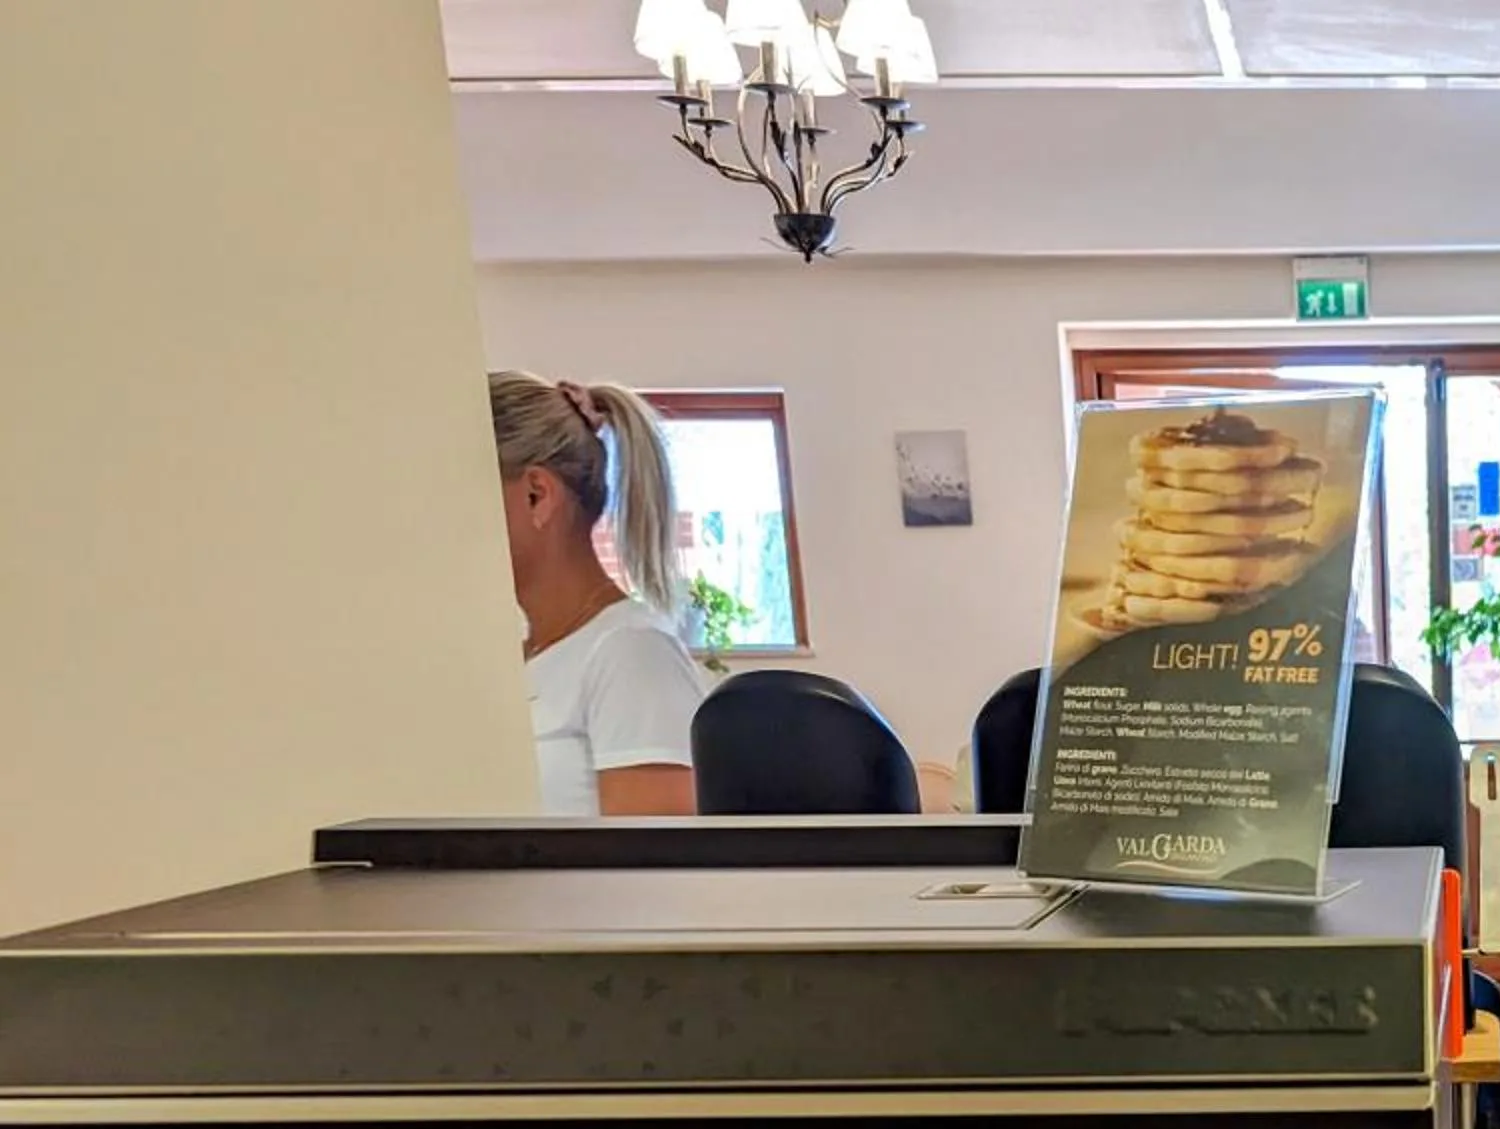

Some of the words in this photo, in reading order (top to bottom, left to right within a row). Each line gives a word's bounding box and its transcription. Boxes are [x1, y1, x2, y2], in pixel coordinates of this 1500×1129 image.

[1152, 643, 1240, 670] LIGHT!
[1247, 623, 1324, 663] 97%
[1243, 666, 1275, 684] FAT
[1276, 666, 1319, 684] FREE
